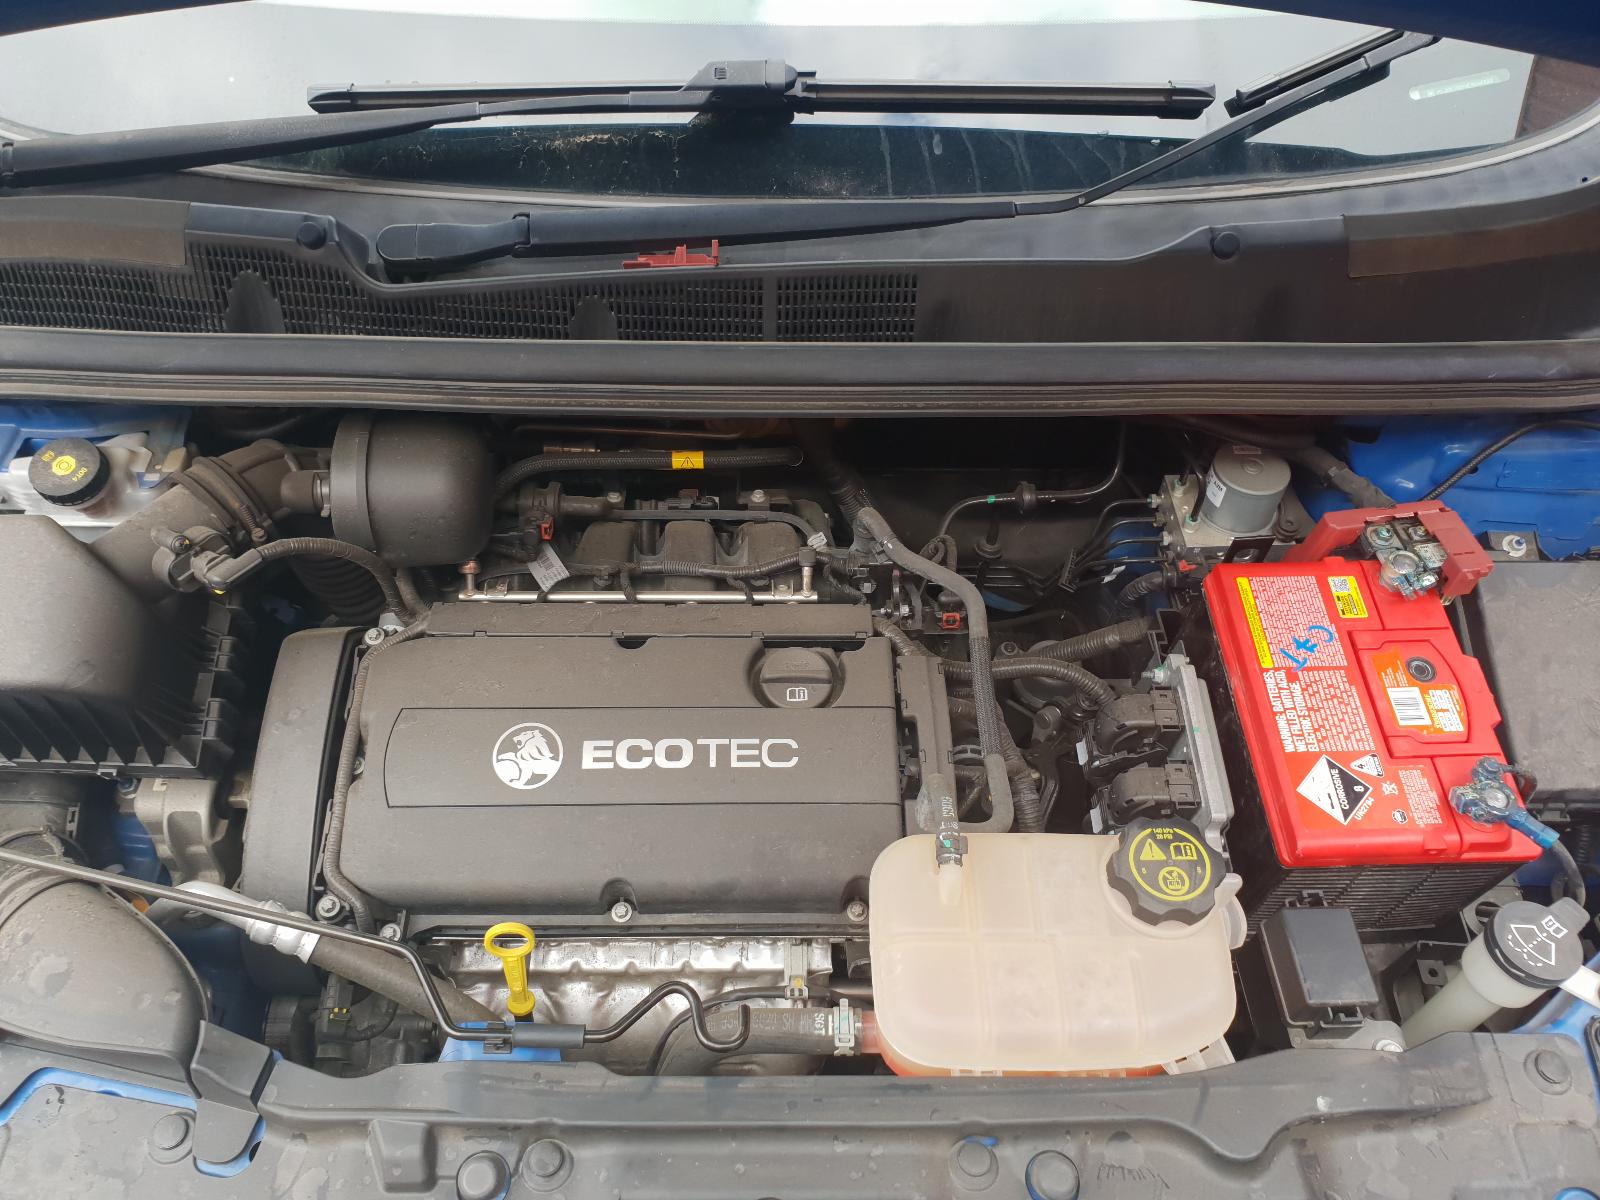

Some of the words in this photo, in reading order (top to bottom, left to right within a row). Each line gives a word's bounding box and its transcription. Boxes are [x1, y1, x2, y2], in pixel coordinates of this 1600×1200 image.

[1263, 669, 1284, 712] BATTERIES,
[1273, 669, 1289, 688] ACID,
[1279, 689, 1295, 709] WITH
[1289, 681, 1309, 716] STORAGE.
[1275, 713, 1296, 753] WARNING:
[1286, 710, 1302, 735] FILLED
[1300, 716, 1319, 752] ELECTRIC
[581, 738, 799, 770] ECOTEC
[1293, 735, 1308, 753] WET
[1330, 768, 1350, 810] CORROSIVE
